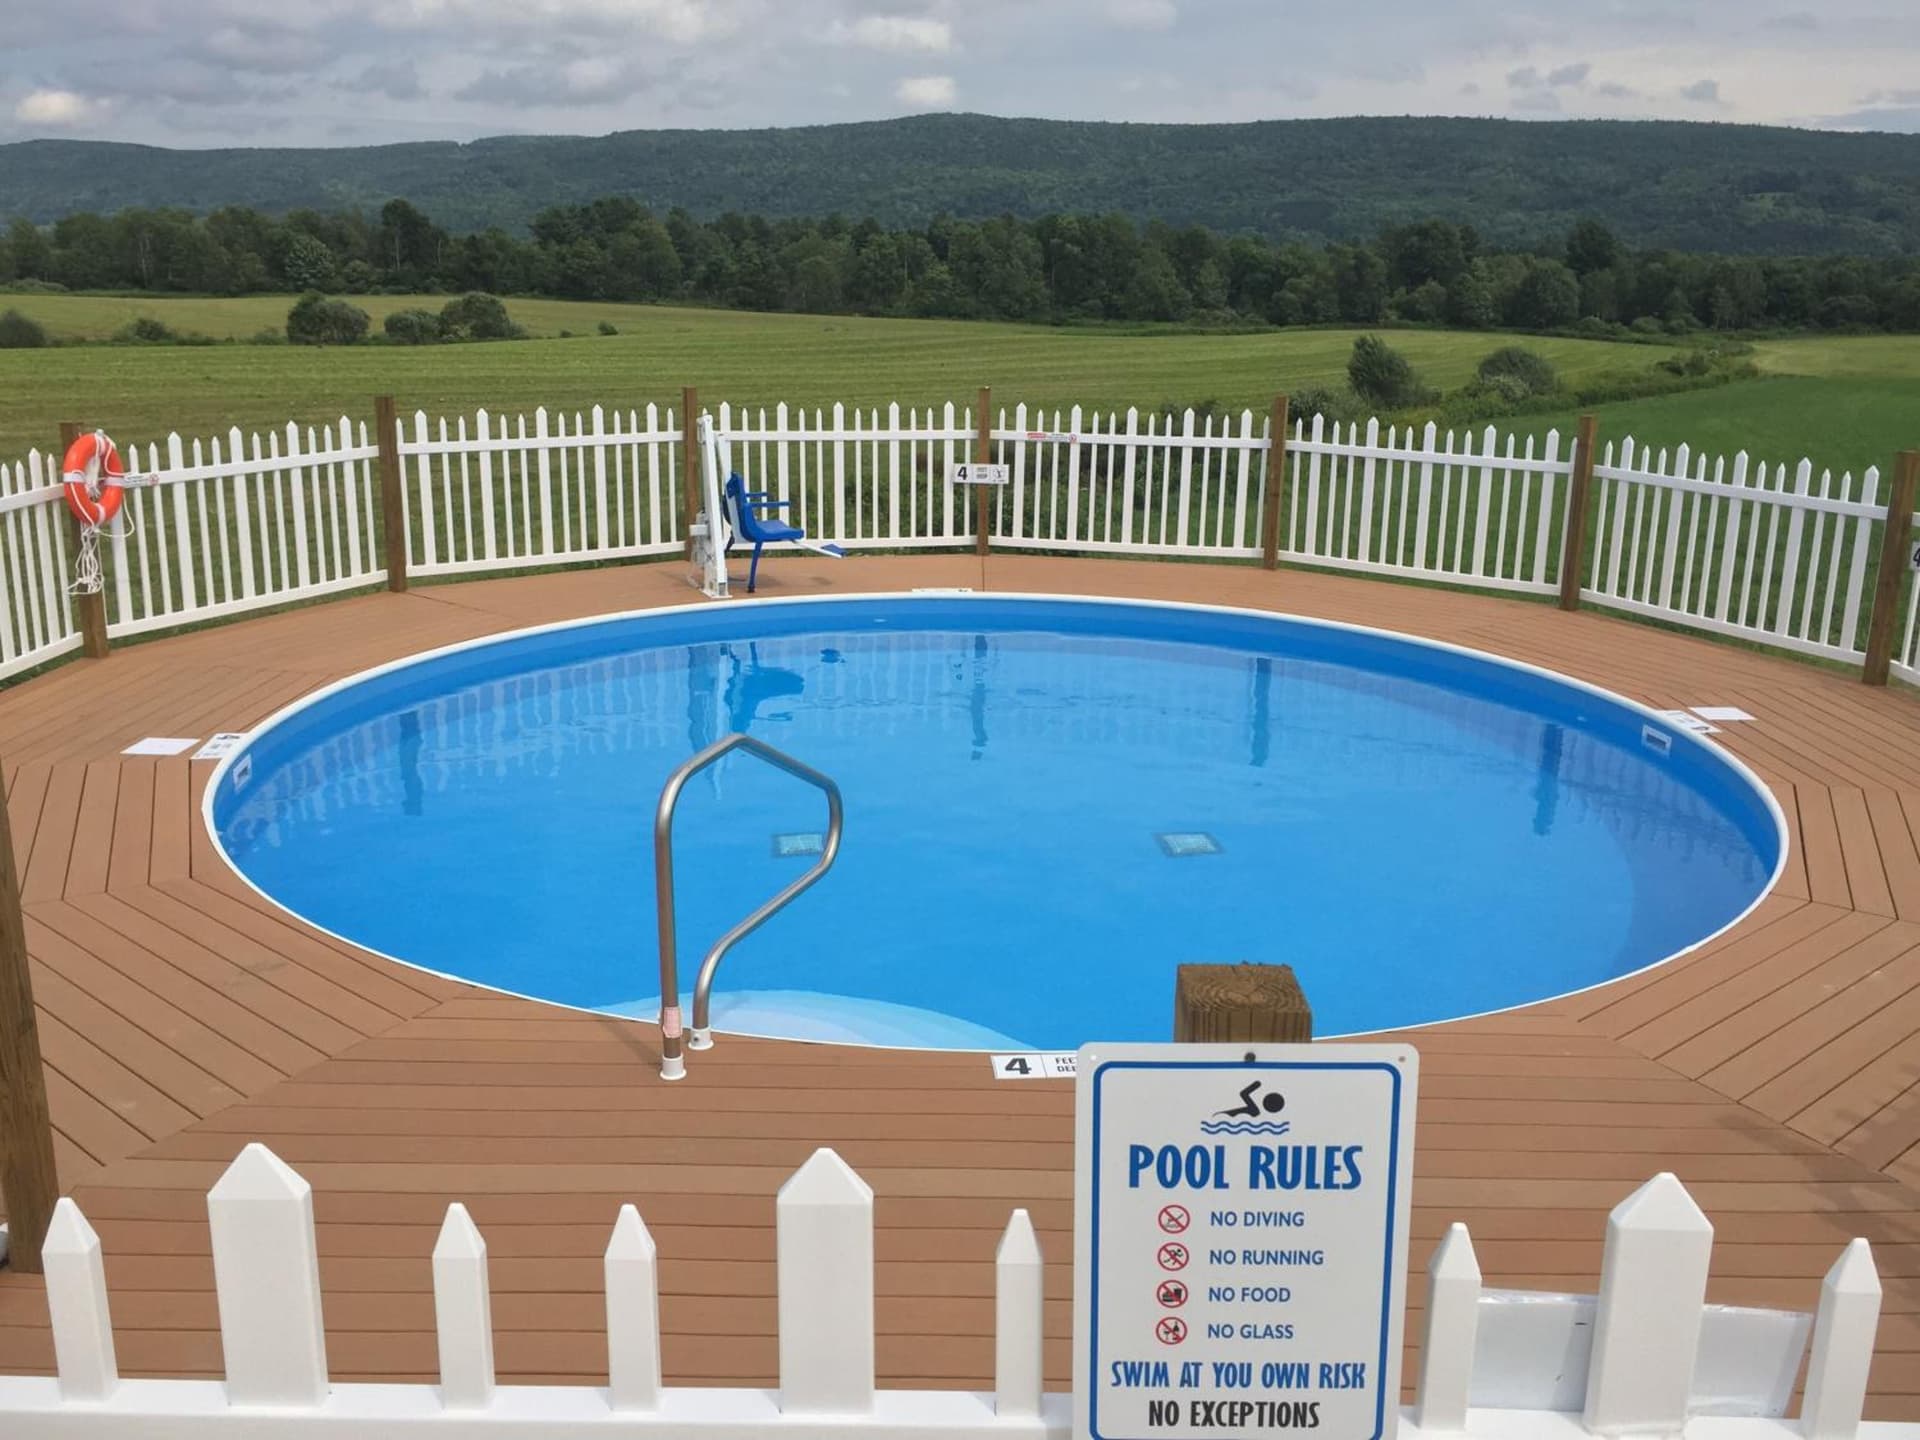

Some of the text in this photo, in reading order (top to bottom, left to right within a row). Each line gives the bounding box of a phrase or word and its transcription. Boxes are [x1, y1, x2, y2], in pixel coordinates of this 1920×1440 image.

[957, 466, 968, 480] 4
[1005, 1057, 1032, 1074] 4
[1055, 1057, 1076, 1065] FEE
[1129, 1144, 1363, 1190] POOL RULES
[1210, 1212, 1305, 1227] NO DIVING
[1209, 1250, 1324, 1266] NO RUNNING
[1208, 1287, 1291, 1302] NO FOOD
[1207, 1324, 1294, 1340] NO GLASS
[1111, 1361, 1366, 1389] SWIM AT YOU OWN RISK
[1148, 1401, 1321, 1428] NO EXCEPTIONS
